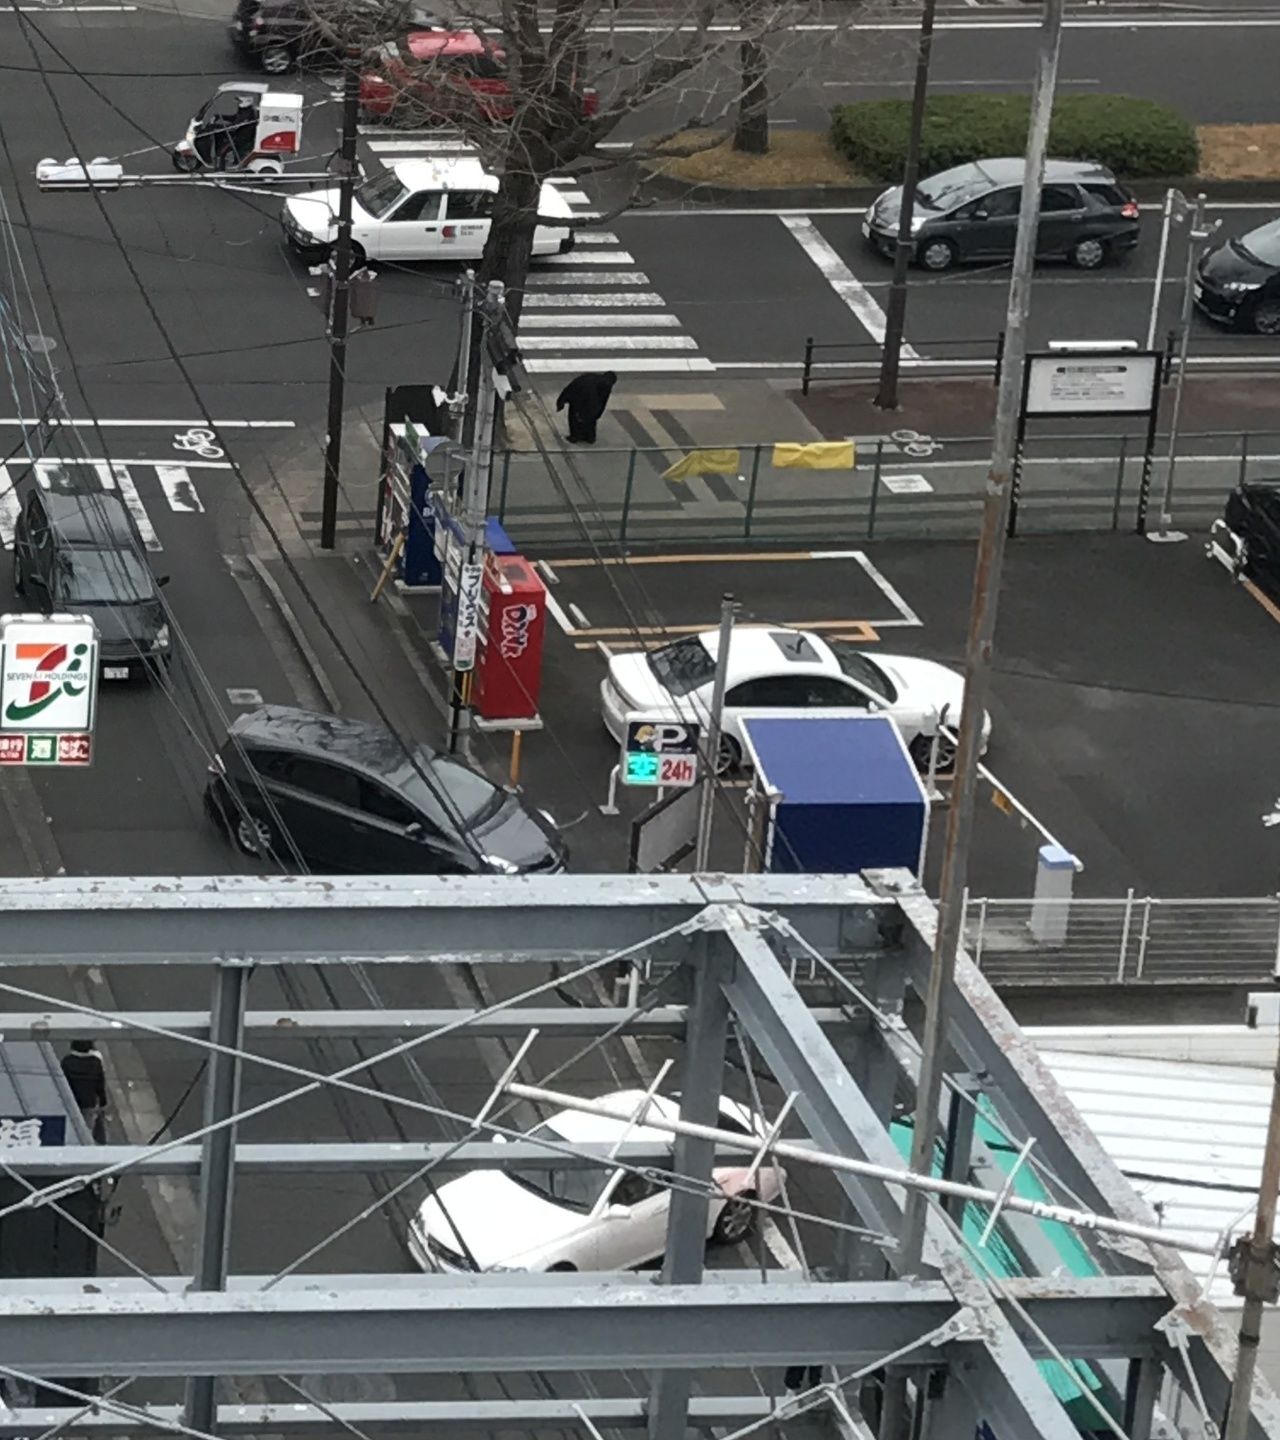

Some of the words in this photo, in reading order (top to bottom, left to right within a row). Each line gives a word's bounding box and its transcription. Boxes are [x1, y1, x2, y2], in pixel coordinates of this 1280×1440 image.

[30, 739, 53, 759] 酒
[59, 739, 89, 759] たばこ
[661, 759, 693, 780] 24h
